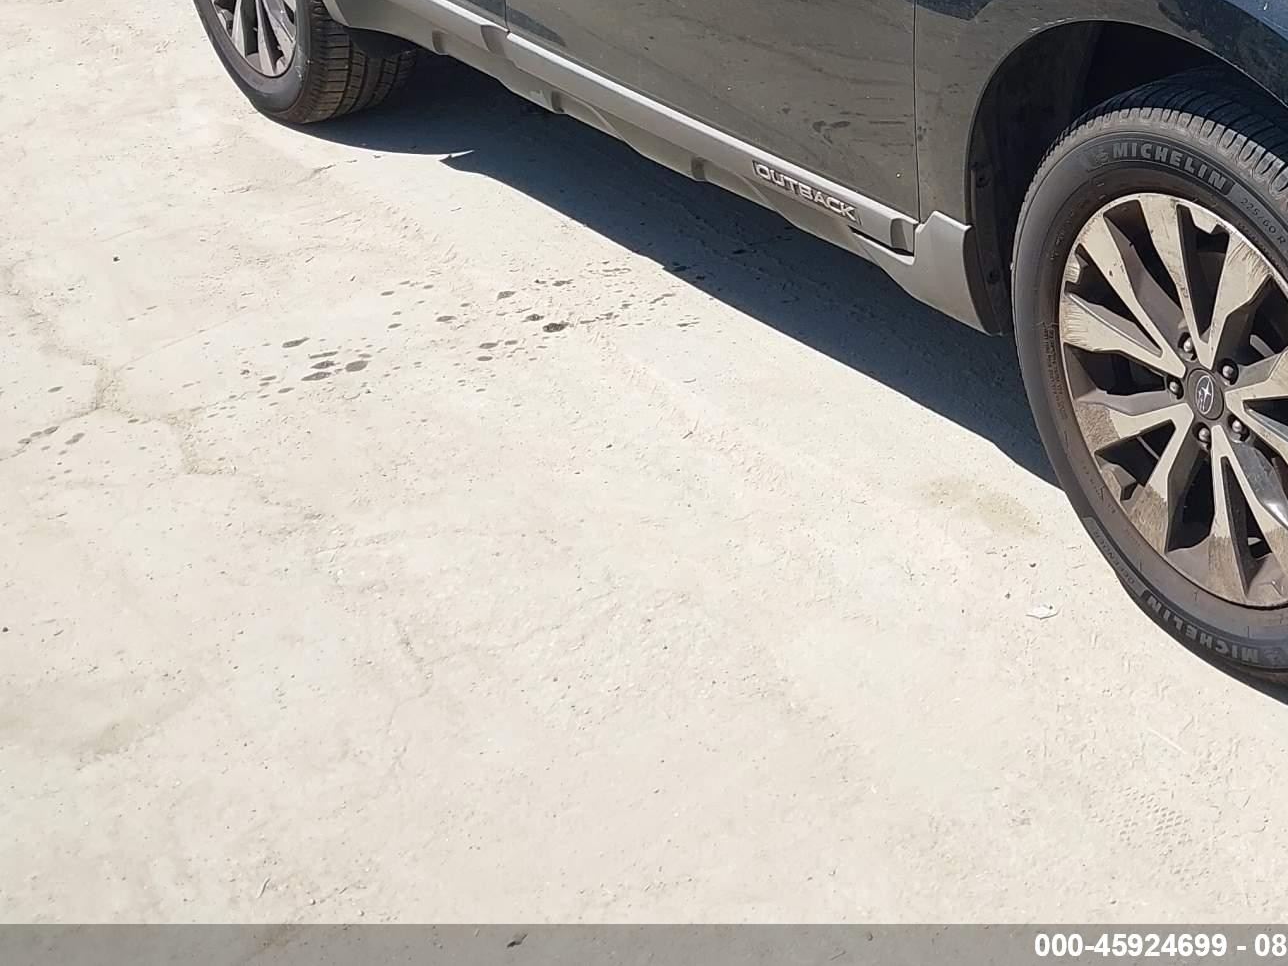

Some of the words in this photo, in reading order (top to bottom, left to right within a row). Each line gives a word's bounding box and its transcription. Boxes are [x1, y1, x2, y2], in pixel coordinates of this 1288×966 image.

[755, 163, 858, 221] OUTBACK
[1112, 142, 1226, 192] MICHELIN
[1240, 197, 1277, 234] 225/60
[1277, 236, 1286, 245] R
[1147, 594, 1259, 663] MICHELIN
